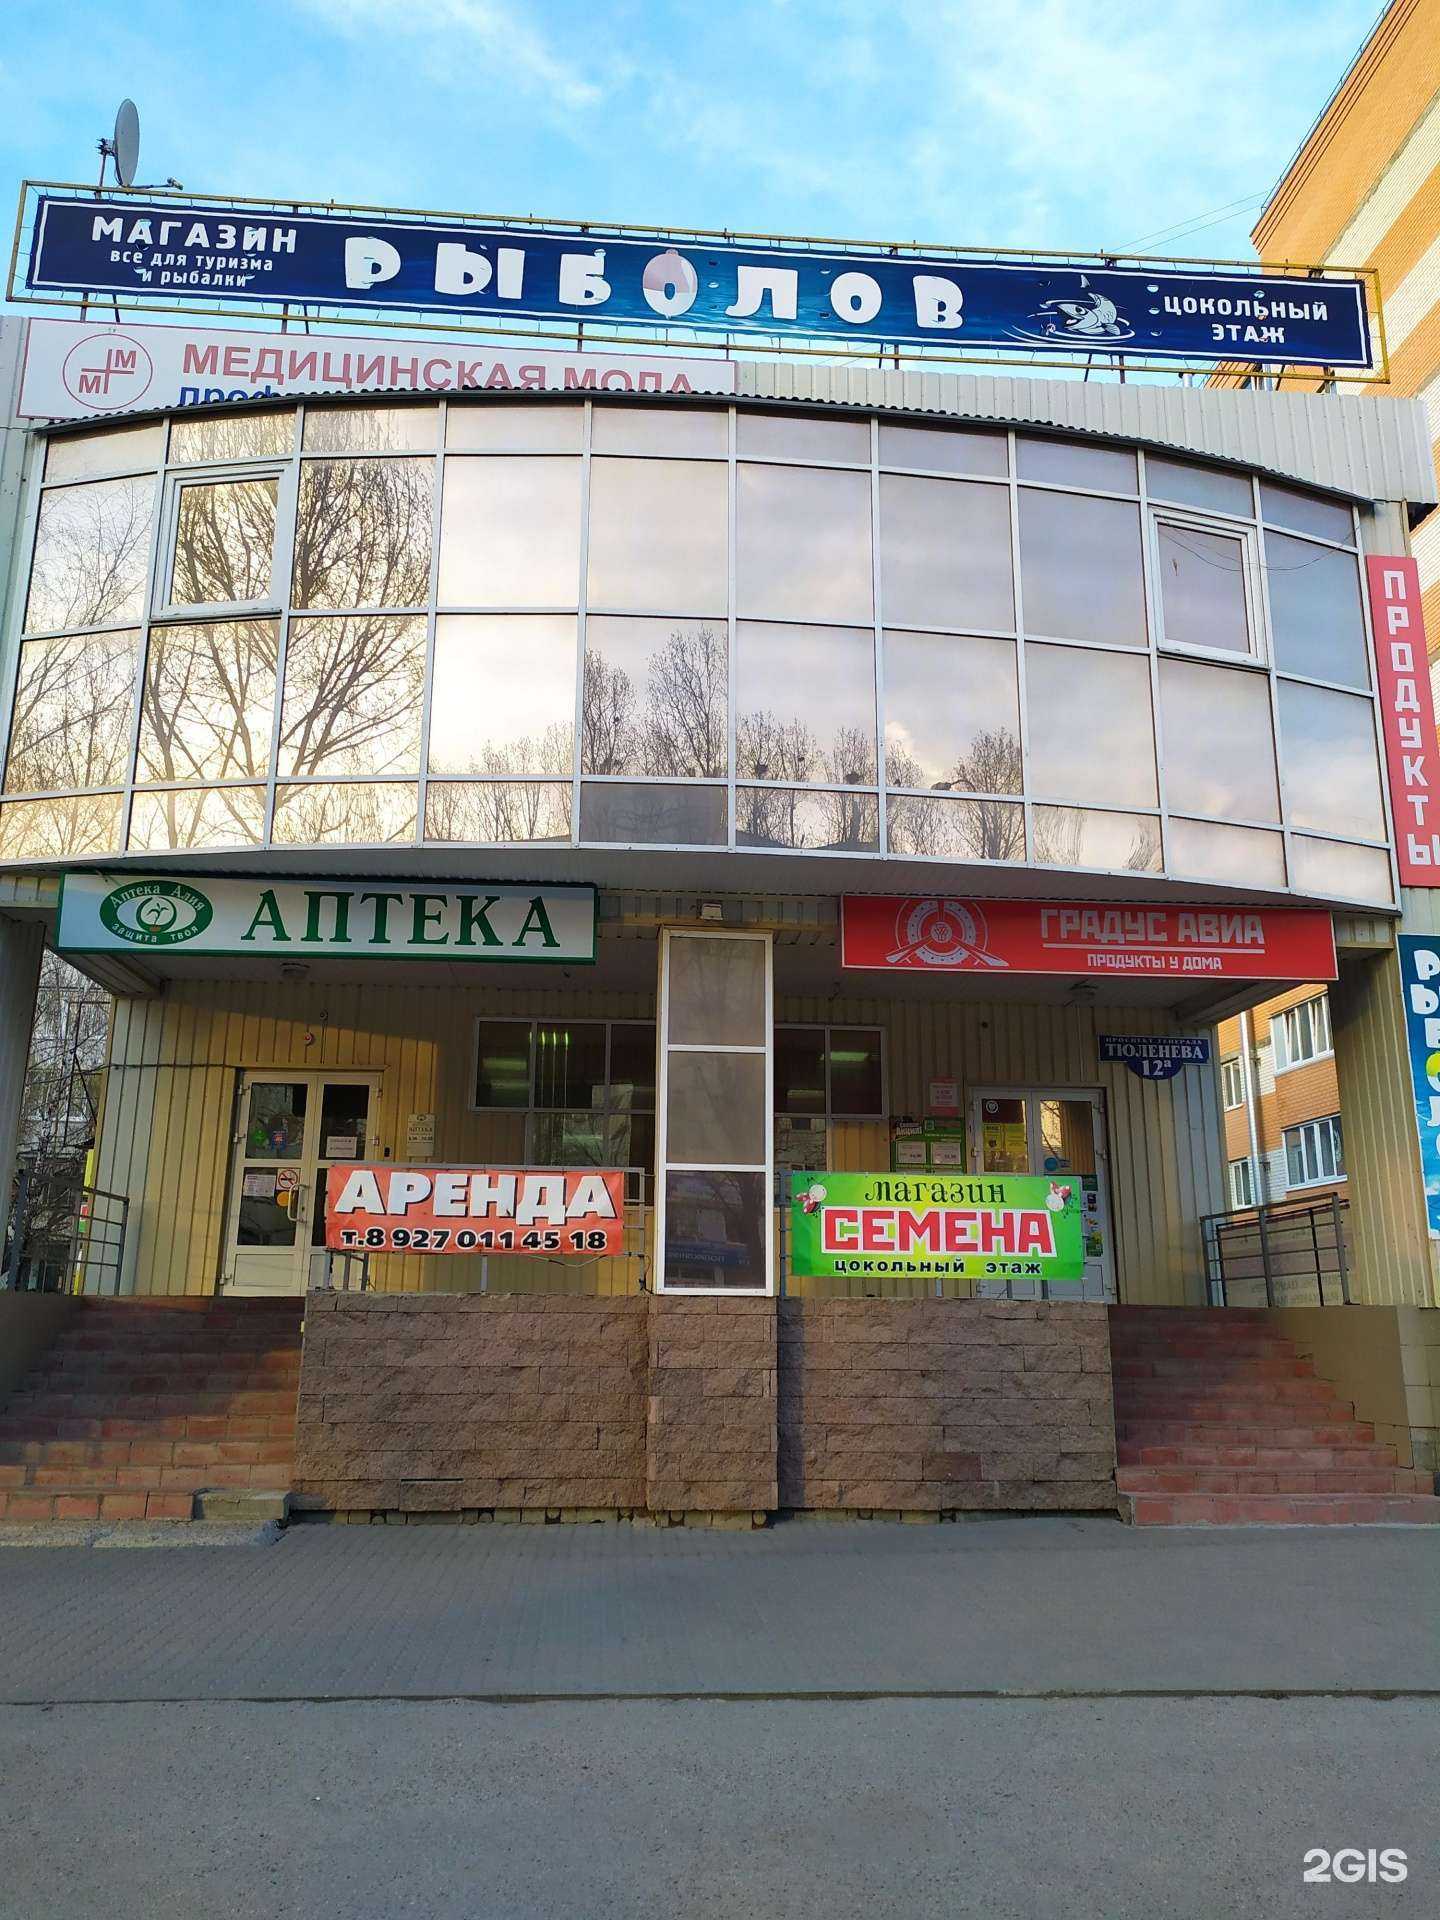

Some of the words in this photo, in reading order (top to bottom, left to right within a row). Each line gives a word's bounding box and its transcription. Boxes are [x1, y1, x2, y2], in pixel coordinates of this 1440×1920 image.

[91, 216, 297, 254] МАГАЗИН
[110, 250, 143, 263] все
[150, 252, 187, 266] для
[195, 254, 273, 271] туризма
[141, 269, 152, 282] и
[160, 270, 249, 288] рыбалки
[345, 236, 964, 329] РЫБОЛОВ
[1164, 295, 1328, 321] ЦОКОЛЬНЫЙ
[1211, 323, 1285, 344] ЭТАЖ
[182, 343, 546, 390] МЕДИЦИНСКАЯ
[1383, 570, 1440, 867] ПРОДУКТЫ
[110, 884, 162, 909] Аптека
[170, 885, 206, 912] Алия
[240, 888, 561, 948] АПТЕКА
[1040, 908, 1168, 944] ГРАДУС
[1177, 912, 1265, 945] АВИА
[111, 923, 158, 943] защита
[170, 925, 199, 941] твоя
[1087, 953, 1166, 969] ПРОДУКТЫ
[1169, 956, 1179, 969] У
[1182, 956, 1223, 970] ДОМА
[1105, 1043, 1204, 1059] ТЮЛЕНЕВА
[334, 1170, 618, 1226] АРЕНДА
[391, 1230, 451, 1250] 927
[456, 1230, 515, 1250] 011
[521, 1231, 561, 1250] 45
[569, 1231, 608, 1250] 18
[823, 1208, 1055, 1255] СЕМЕНА
[834, 1256, 965, 1274] цокольный
[985, 1261, 1042, 1275] этаж
